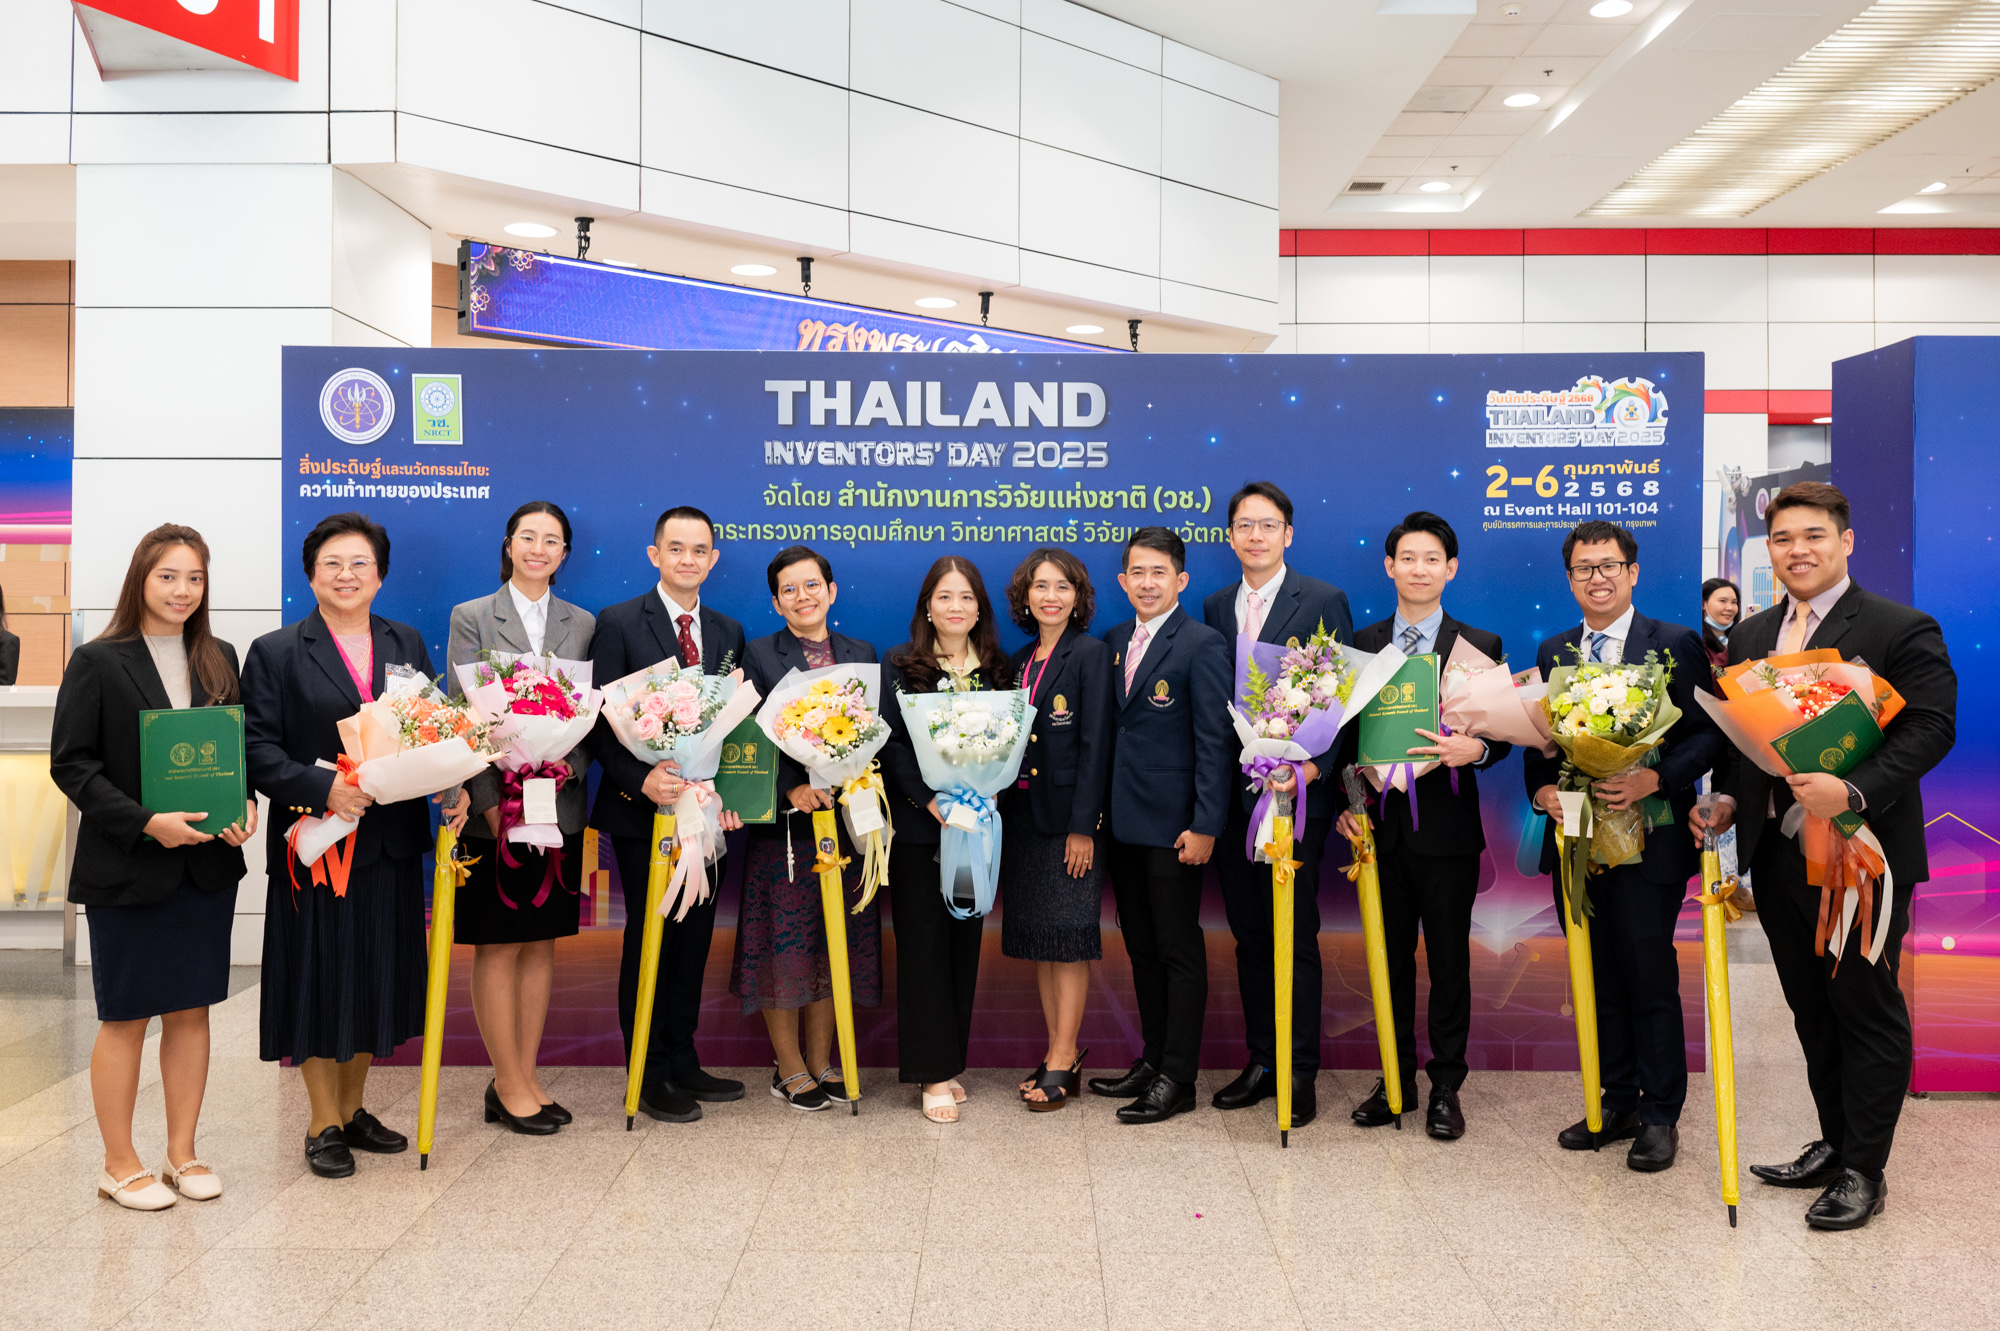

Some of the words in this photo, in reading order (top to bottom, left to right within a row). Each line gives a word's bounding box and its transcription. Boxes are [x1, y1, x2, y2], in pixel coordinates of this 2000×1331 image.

[764, 380, 1107, 428] THAILAND
[1489, 392, 1566, 406] วันนักประดิษฐ์
[1567, 394, 1594, 403] 2568
[427, 418, 450, 428] วช.
[1489, 409, 1595, 425] THAILAND
[423, 429, 452, 437] NRCT
[1584, 430, 1615, 444] DAY
[1616, 430, 1663, 444] 2025
[947, 441, 1008, 468] DAY
[1012, 441, 1109, 468] 2025
[299, 453, 490, 479] สิ่งประดิษฐ์และนวัตกรรมไทย:
[1563, 459, 1661, 480] กุมภาพันธ์
[299, 478, 490, 499] ความท้าทายของประเทศ
[763, 483, 831, 507] จัดโดย
[838, 480, 1147, 509] สำนักงานการวิจัยแห่งชาติ
[1153, 485, 1212, 513] (วช.)
[1483, 505, 1500, 516] ณ
[1504, 503, 1554, 516] Event
[1558, 503, 1591, 516] Hall
[1595, 502, 1659, 515] 101-104
[951, 520, 1079, 543] วิทยาศาสตร์
[1625, 520, 1657, 530] กรุงเทพฯ
